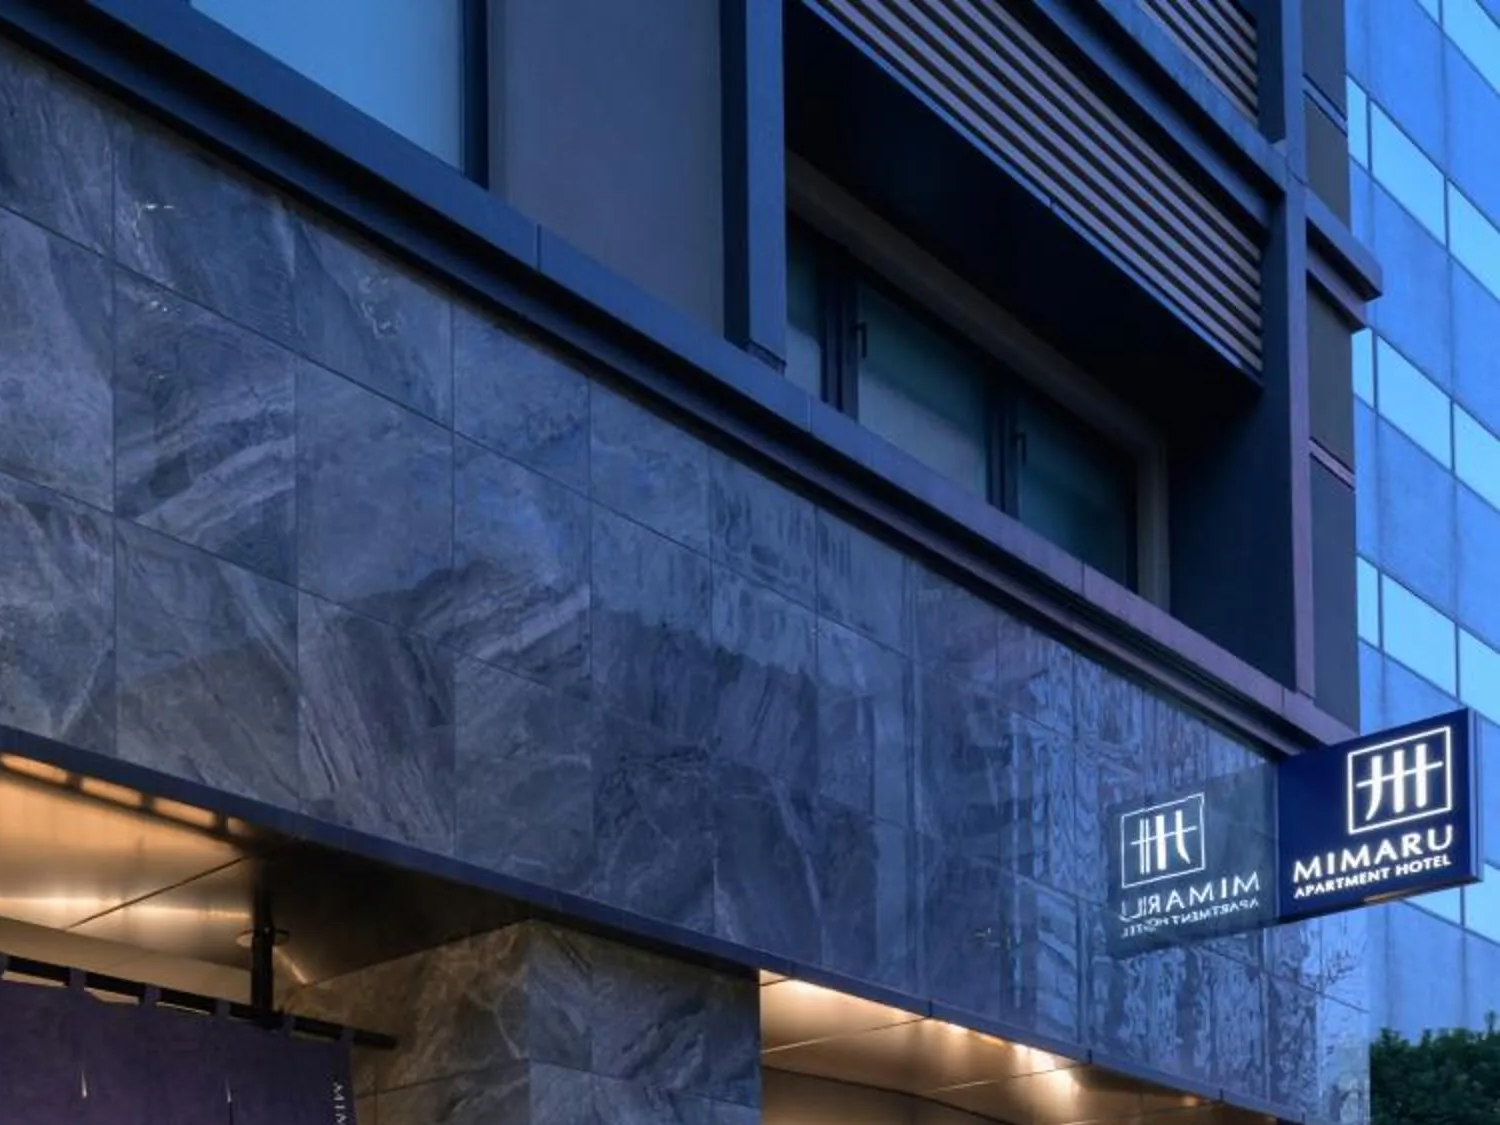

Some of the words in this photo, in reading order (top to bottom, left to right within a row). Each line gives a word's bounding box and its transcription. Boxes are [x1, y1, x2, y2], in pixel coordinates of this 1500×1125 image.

[1293, 825, 1453, 883] MIMARU
[1294, 867, 1391, 899] APARTMENT
[1395, 854, 1452, 876] HOTEL
